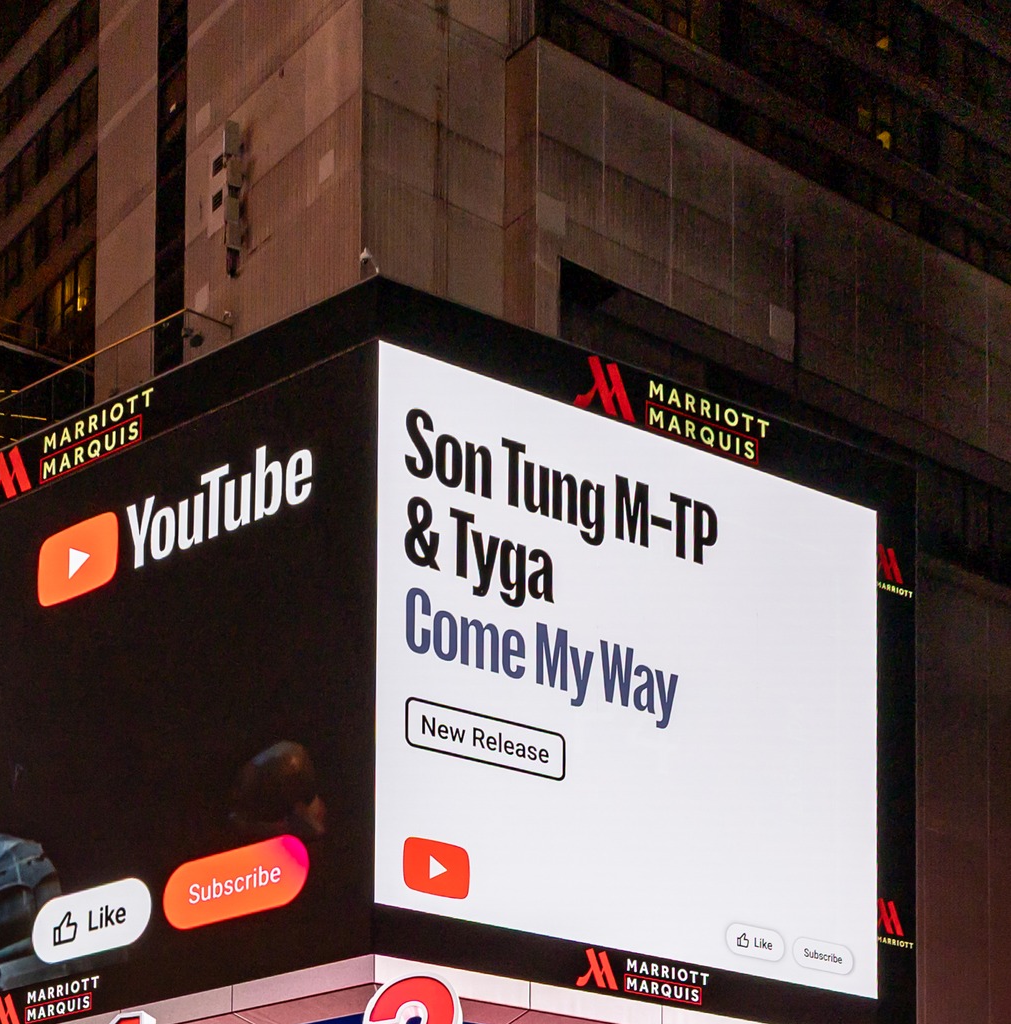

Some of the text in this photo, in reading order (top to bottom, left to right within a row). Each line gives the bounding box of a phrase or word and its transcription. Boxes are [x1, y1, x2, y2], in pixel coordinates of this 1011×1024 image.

[43, 388, 154, 453] MARRIOTT
[649, 380, 770, 439] MARRIOTT
[649, 407, 755, 460] MARQUIS
[42, 421, 140, 480] MARQUIS
[405, 408, 492, 499] Son
[501, 437, 605, 546] Tung
[126, 445, 313, 569] YouTube
[404, 497, 555, 608] & Tyga
[406, 587, 679, 730] Come My Way
[421, 714, 550, 765] New Release
[189, 865, 282, 905] Subscribe
[88, 906, 126, 931] Like
[754, 937, 773, 950] Like
[626, 958, 710, 985] MARRIOTT
[803, 948, 843, 964] Subscribe
[26, 975, 100, 1004] MARRIOTT
[26, 995, 91, 1022] MARQUIS
[626, 977, 700, 1002] MARQUIS
